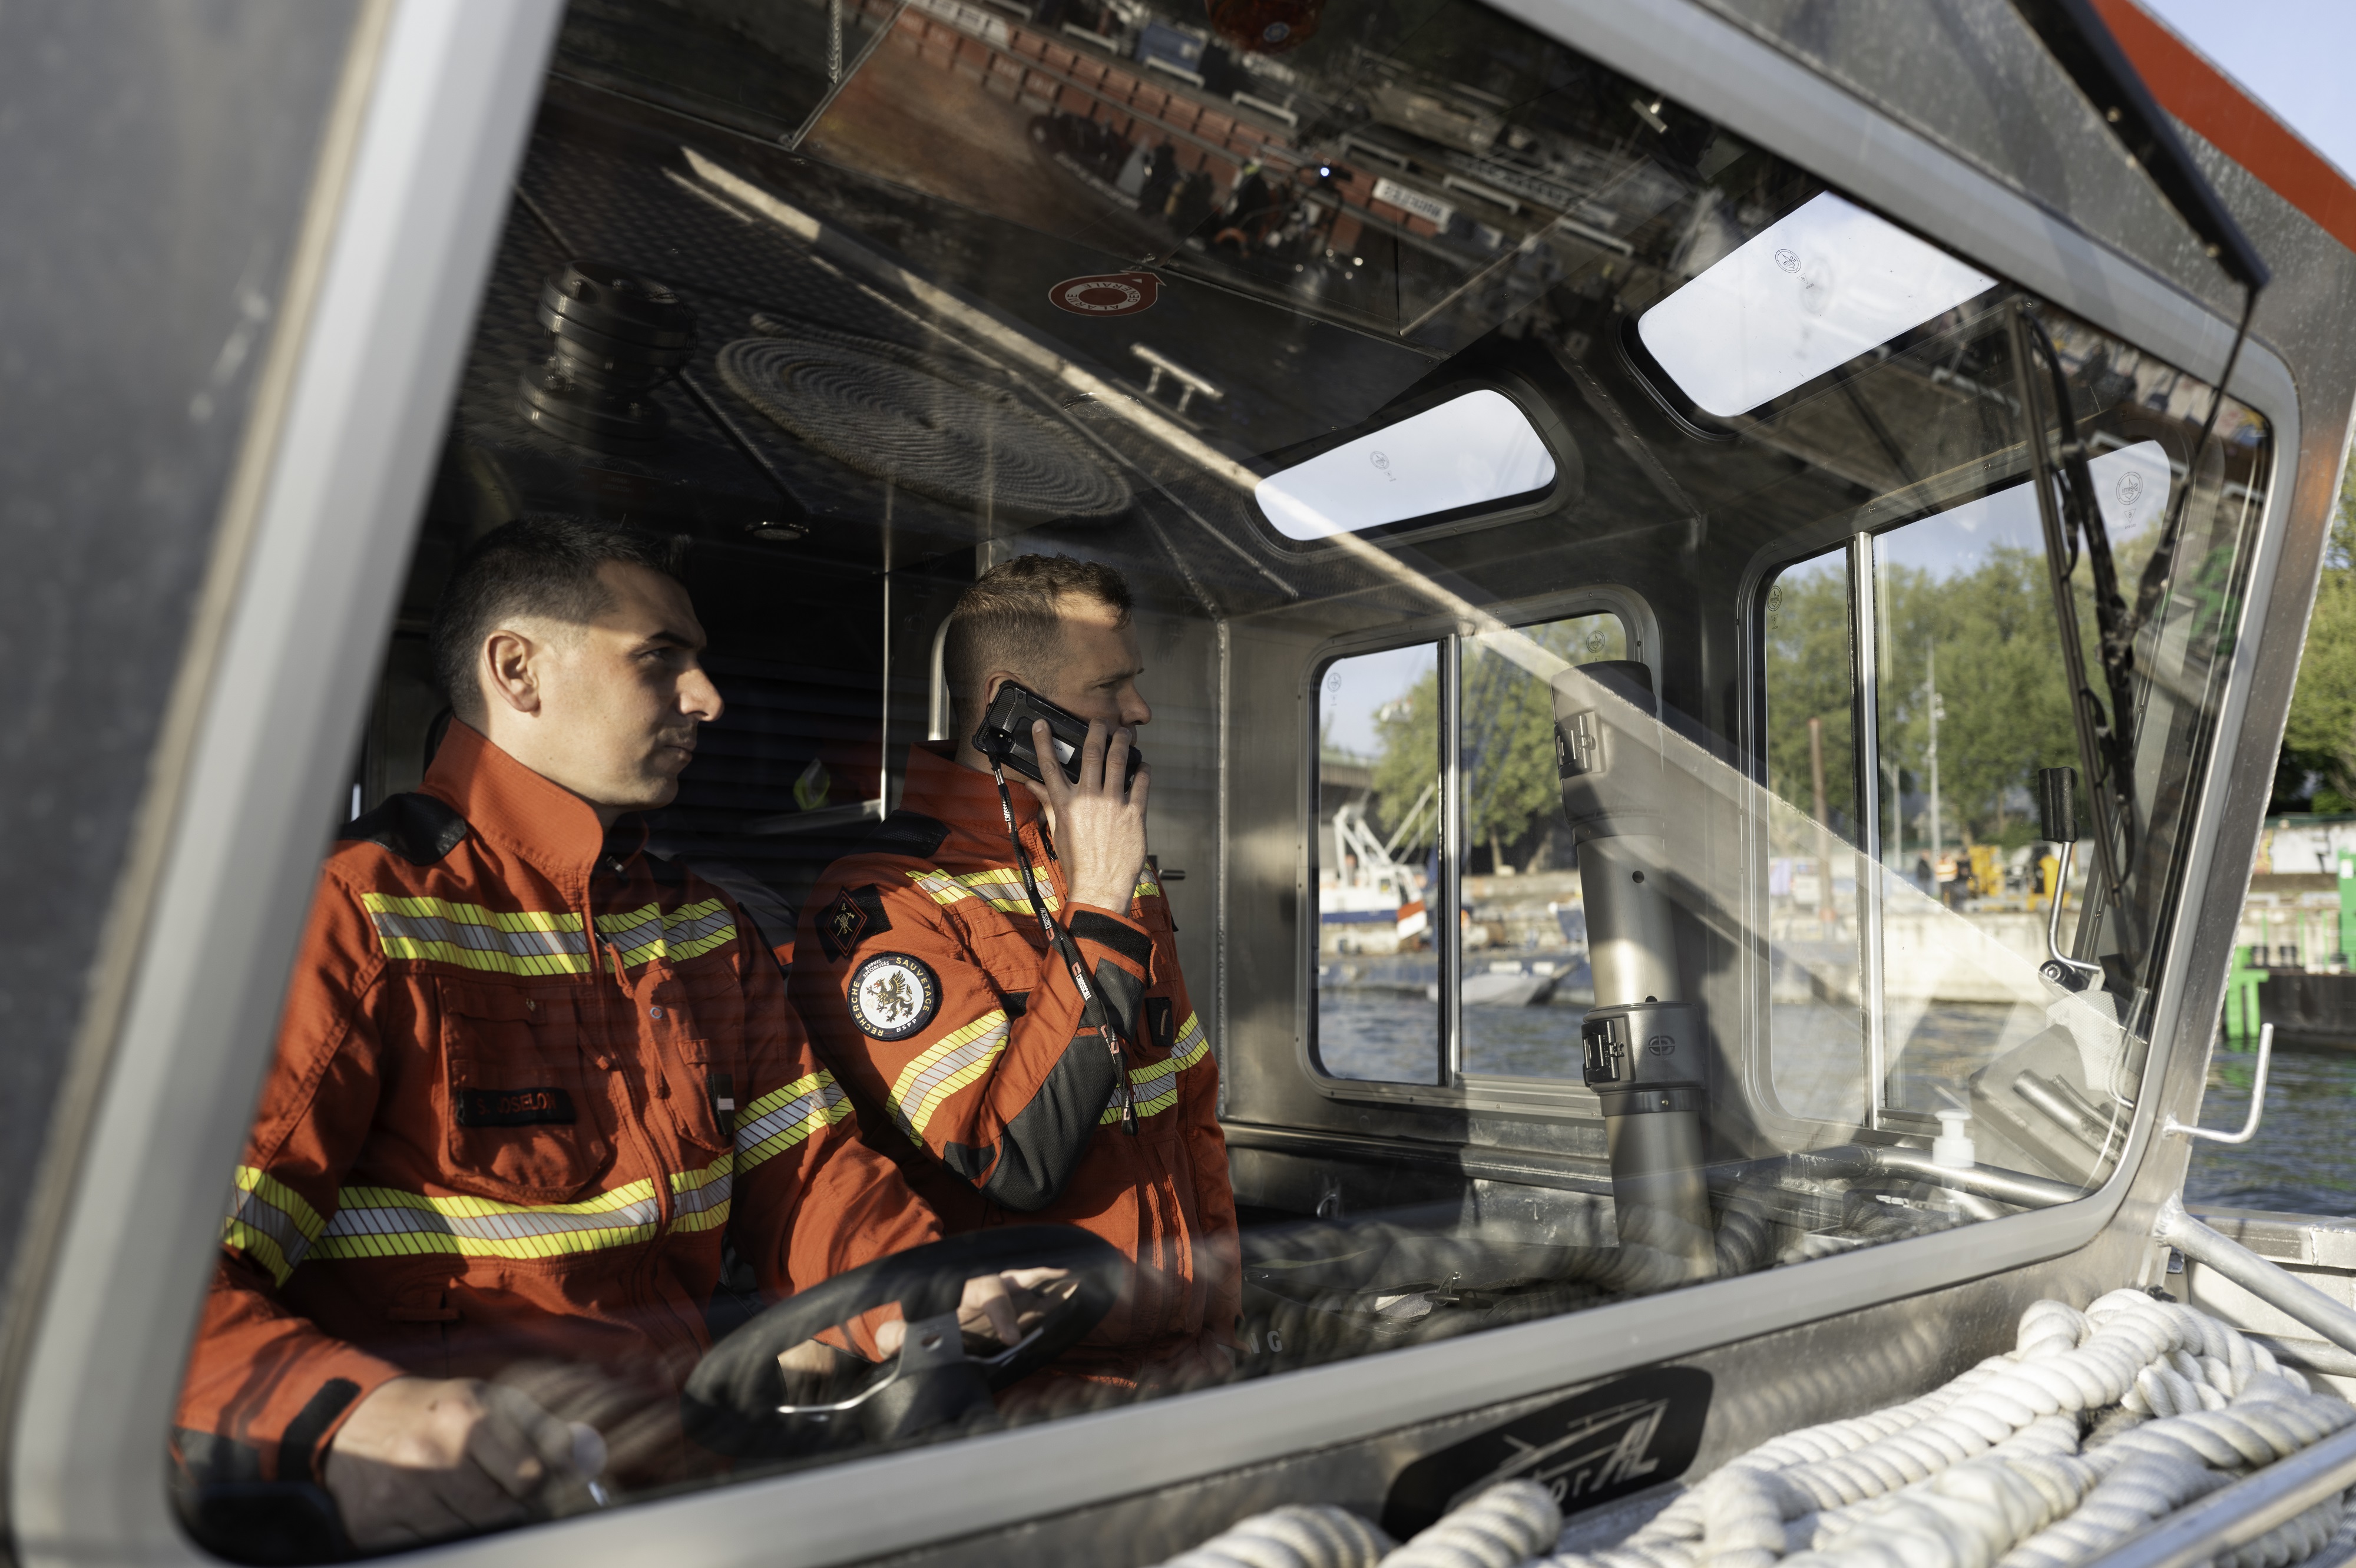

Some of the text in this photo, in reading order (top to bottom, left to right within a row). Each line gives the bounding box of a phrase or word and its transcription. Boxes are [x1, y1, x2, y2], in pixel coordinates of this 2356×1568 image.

[1067, 283, 1140, 310] ALARME GENERALE
[863, 961, 889, 978] SPÉCIALISÉS
[865, 959, 882, 971] APPUIS
[896, 957, 932, 1012] SAUVETAGE
[1076, 974, 1092, 1001] CROSSCALL
[851, 980, 884, 1037] RECHERCHE
[896, 1018, 917, 1033] BSPP
